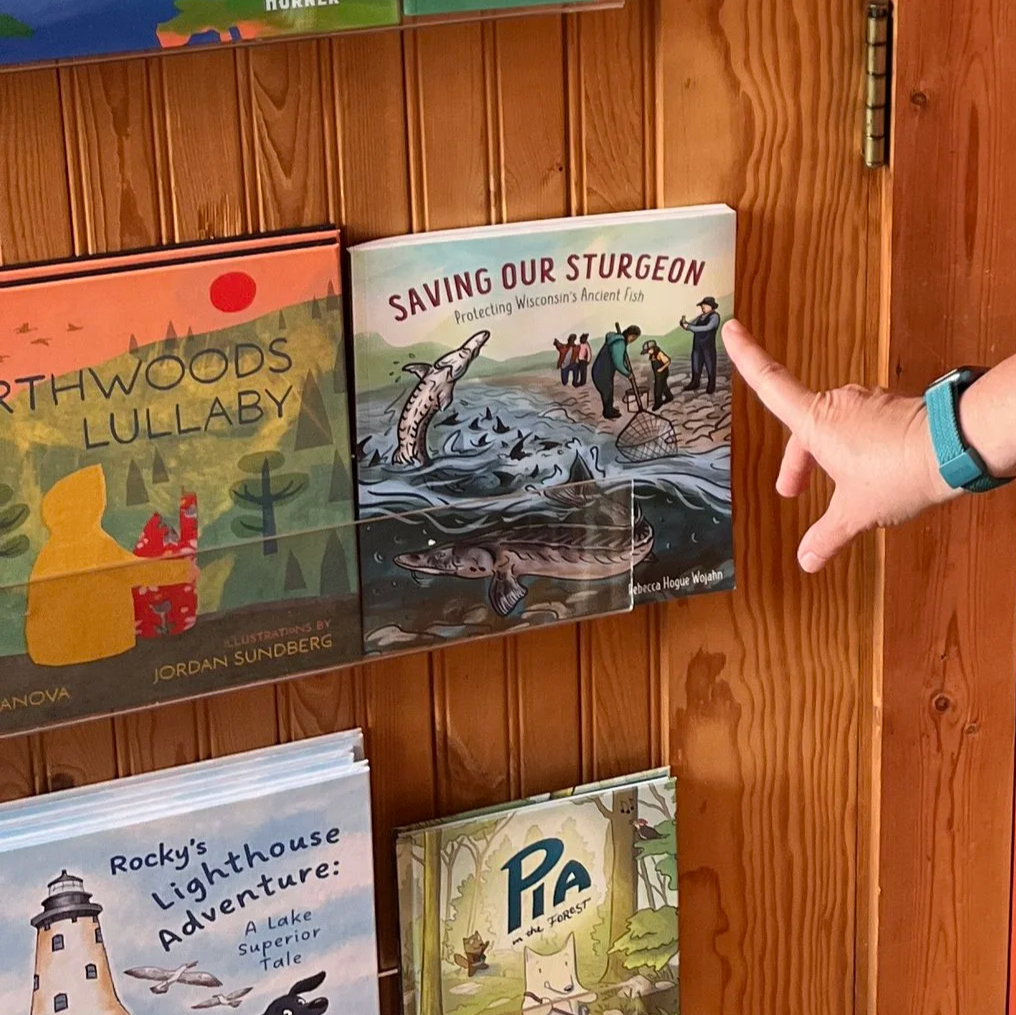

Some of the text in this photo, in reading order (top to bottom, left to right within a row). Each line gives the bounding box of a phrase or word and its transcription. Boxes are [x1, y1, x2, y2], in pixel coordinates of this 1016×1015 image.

[388, 252, 706, 323] SAVING OUR STURGEON
[454, 286, 645, 325] Protecting Wisconsin's Ancient Fish
[83, 385, 293, 450] LULLABY
[662, 575, 690, 591] Hogue
[691, 569, 723, 586] Wojahn
[226, 618, 332, 648] ILLUSTRATIONS BY
[152, 634, 333, 684] JORDAN SUNDBERG
[0, 687, 71, 711] ANOVA
[110, 838, 208, 876] Rocky's
[151, 826, 341, 911] Lighthouse
[500, 837, 592, 935] PIA
[158, 859, 340, 952] Adventure:
[244, 908, 312, 936] A Lake
[238, 926, 321, 957] Superior
[526, 926, 545, 937] the
[260, 950, 302, 972] Tale
